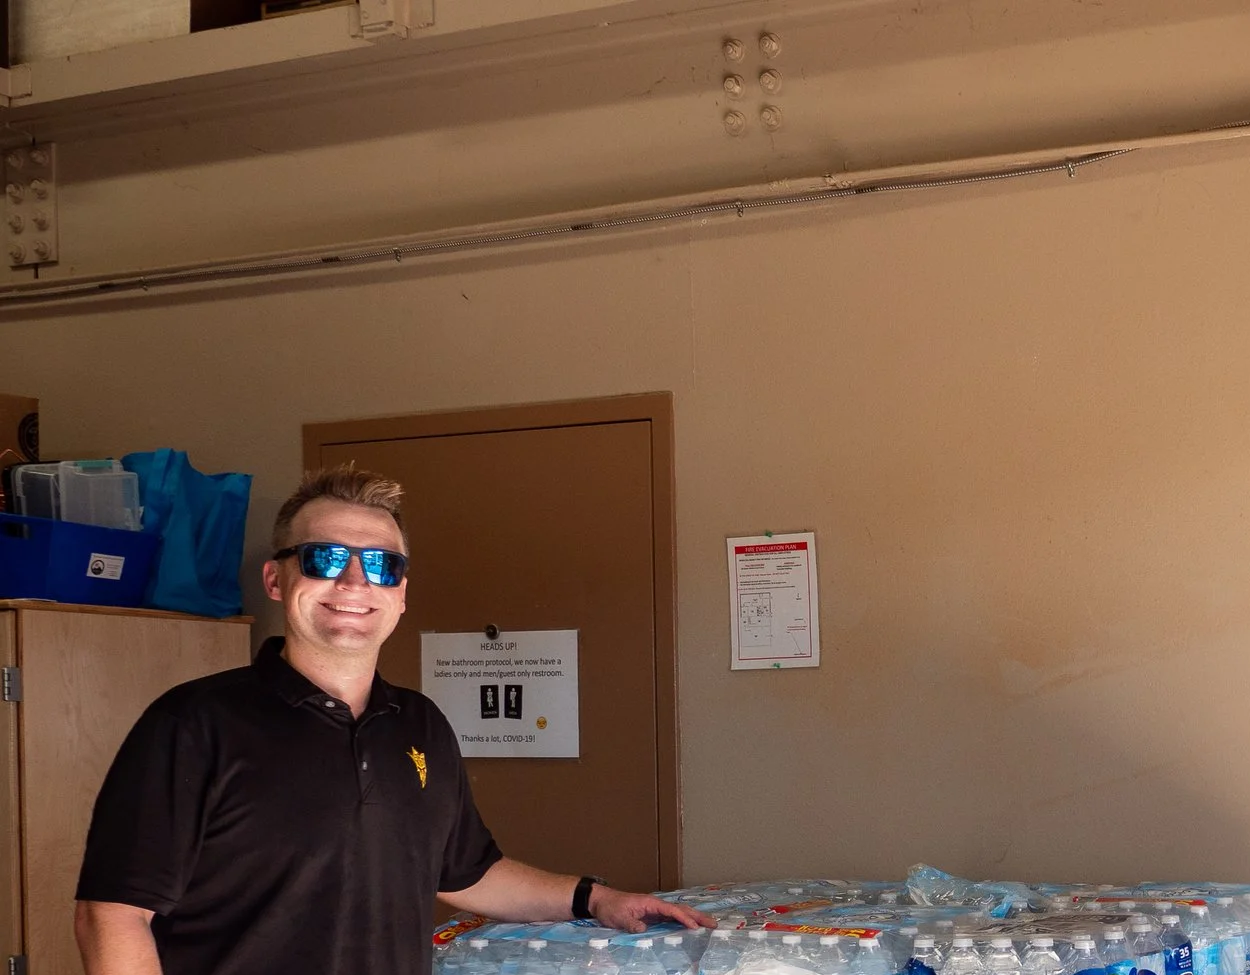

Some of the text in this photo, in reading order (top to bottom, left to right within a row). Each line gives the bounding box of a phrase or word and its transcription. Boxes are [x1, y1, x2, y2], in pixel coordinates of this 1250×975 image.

[480, 643, 504, 651] HEADS
[451, 658, 484, 666] bathroom
[485, 658, 512, 668] protocol,
[539, 658, 556, 666] have
[453, 670, 467, 679] only
[482, 670, 516, 679] men/guest
[517, 670, 531, 679] only
[531, 669, 564, 677] restroom.
[461, 735, 485, 743] Thanks
[491, 735, 502, 744] lot,
[502, 735, 536, 743] COVID-19!
[1179, 946, 1190, 958] 35
